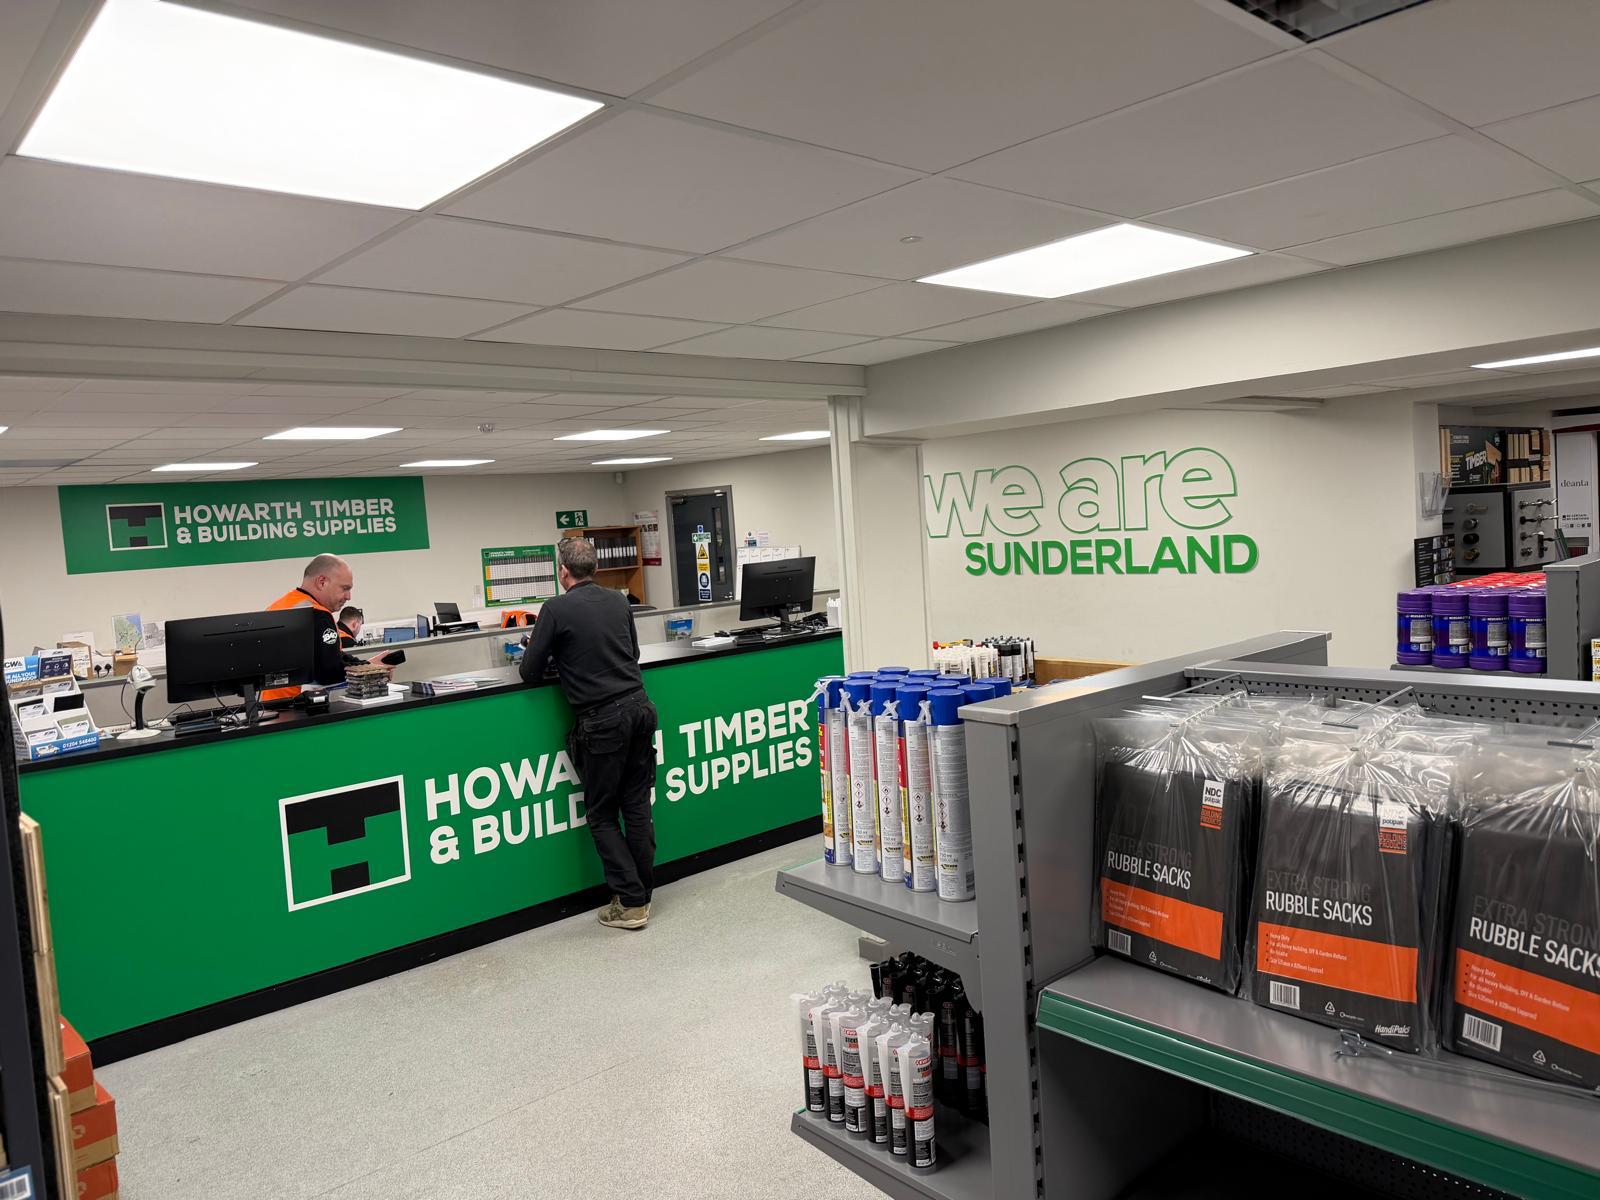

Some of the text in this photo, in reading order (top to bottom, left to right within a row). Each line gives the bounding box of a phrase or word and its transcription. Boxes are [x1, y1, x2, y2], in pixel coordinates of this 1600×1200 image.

[1465, 450, 1487, 470] TIMBER
[923, 447, 1238, 538] we are
[1560, 479, 1589, 487] deanta
[174, 498, 395, 524] HOWARTH TIMBER
[176, 516, 397, 544] & BUILDING SUPPLIES
[965, 534, 1260, 576] SUNDERLAND
[425, 730, 664, 821] HOWA
[679, 700, 811, 758] TIMBER
[430, 825, 460, 864] &
[472, 787, 657, 855] BUILD
[665, 736, 813, 802] SUPPLIES
[1205, 786, 1222, 797] NDC
[1107, 850, 1192, 890] RUBBLE SACKS
[1145, 840, 1193, 869] STRONG
[1266, 870, 1371, 904] EXTRA STRONG
[1265, 890, 1373, 927] RUBBLE SACKS
[1472, 895, 1600, 953] EXTRA STRON
[1469, 916, 1542, 958] RUBBLE
